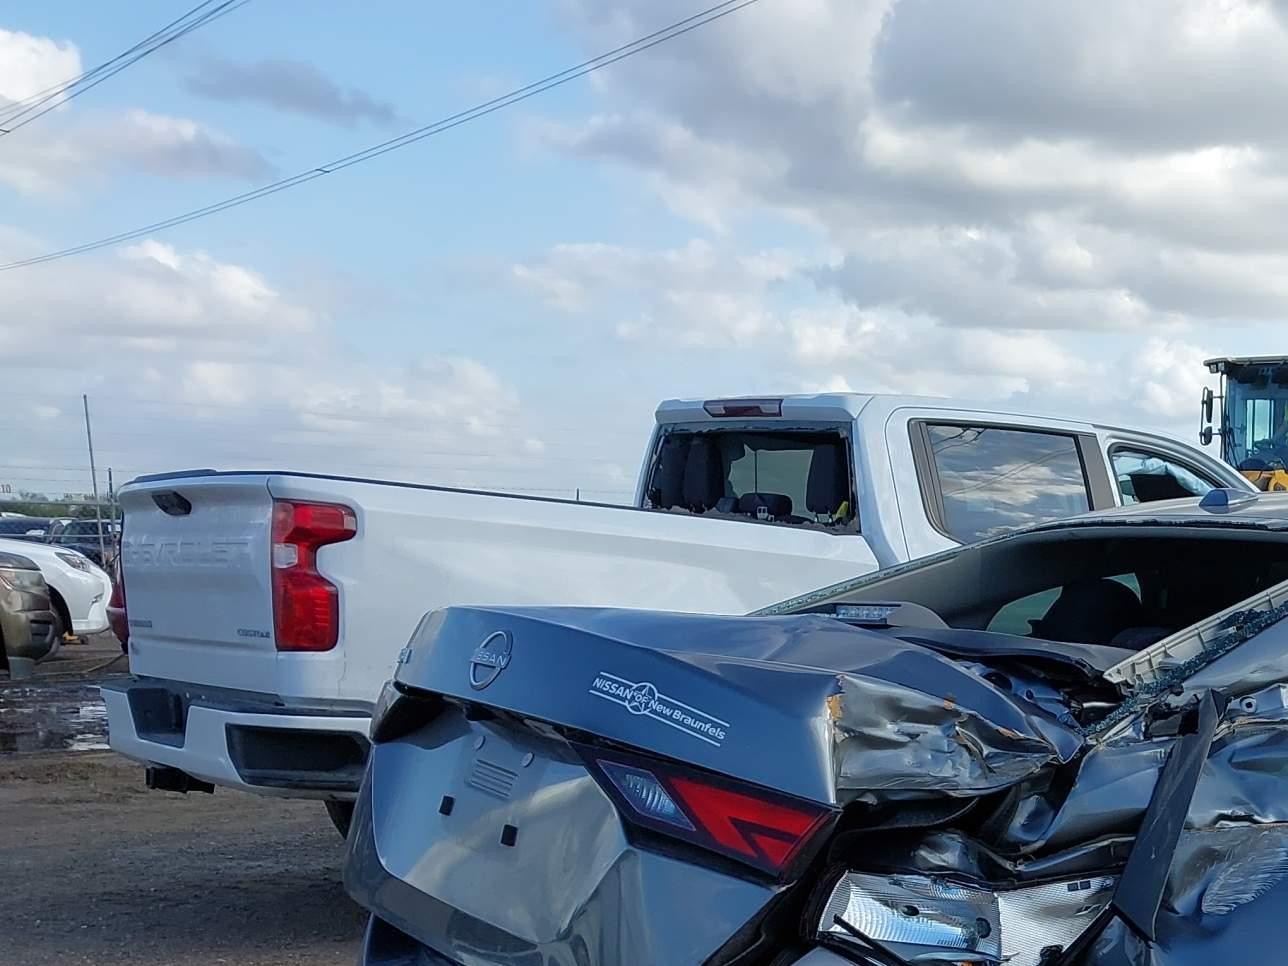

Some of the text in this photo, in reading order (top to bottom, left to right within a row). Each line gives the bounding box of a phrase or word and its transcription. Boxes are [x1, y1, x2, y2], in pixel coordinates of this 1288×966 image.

[592, 677, 634, 700] NISSAN
[648, 700, 672, 716] New
[672, 710, 726, 740] Braunfels
